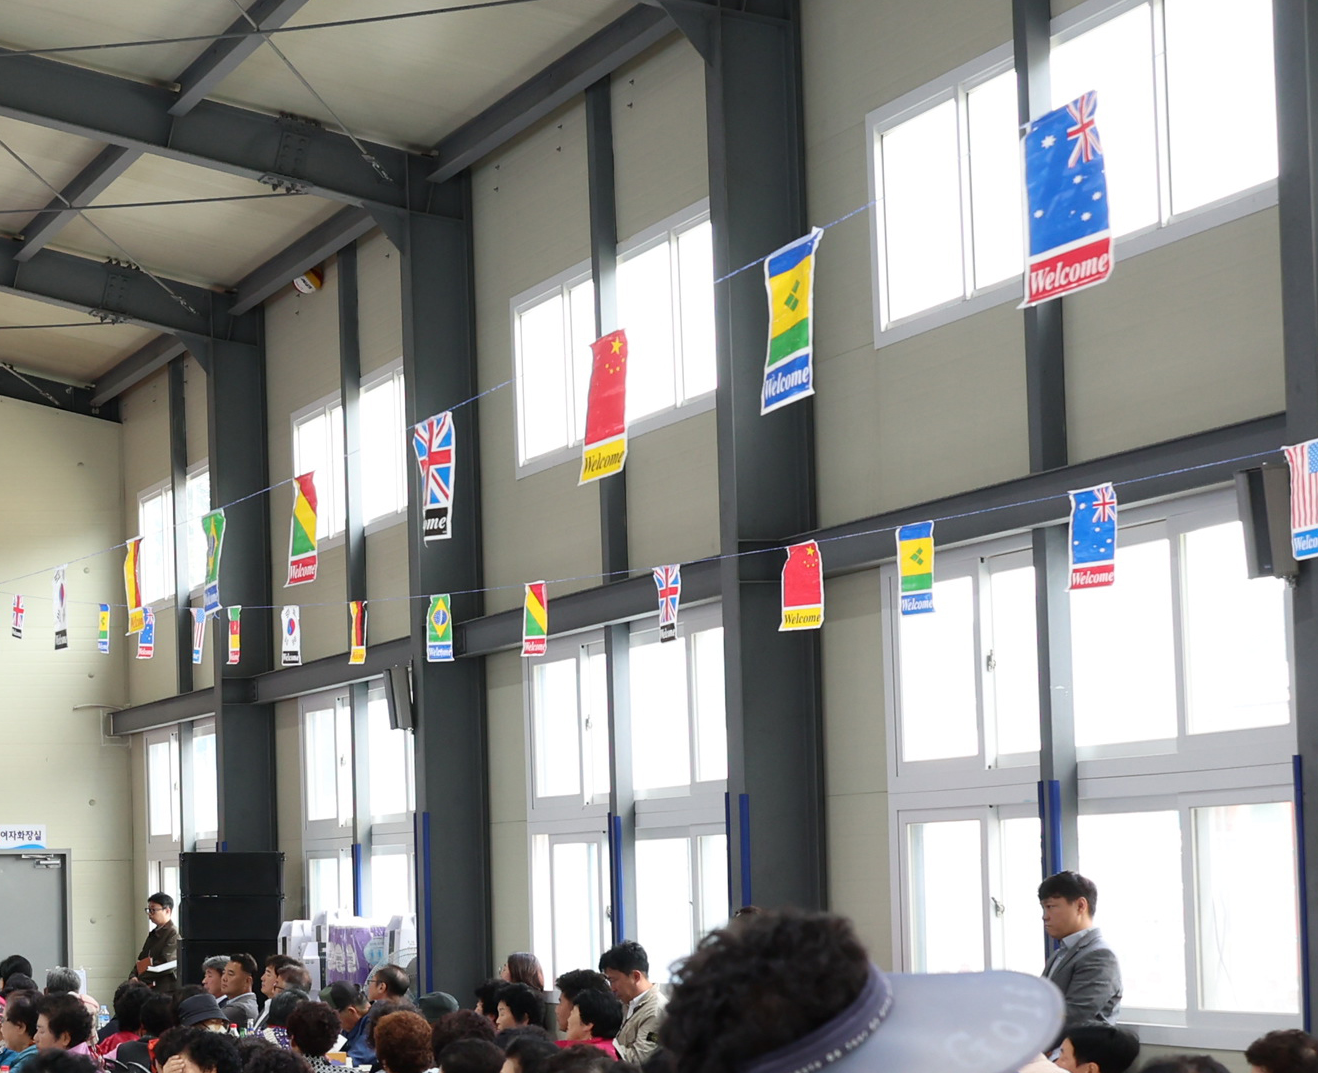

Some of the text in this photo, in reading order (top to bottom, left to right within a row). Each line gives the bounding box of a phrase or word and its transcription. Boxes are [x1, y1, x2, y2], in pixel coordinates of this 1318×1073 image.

[1030, 251, 1109, 295] Welcome
[765, 367, 809, 398] Welcome
[585, 450, 624, 474] Welcome
[289, 562, 316, 581] Welcome
[1072, 568, 1114, 585] Welcome
[901, 597, 933, 612] Welcome
[784, 612, 821, 626] Welcome
[524, 641, 546, 653] Welcome
[0, 830, 42, 841] 여자화장실
